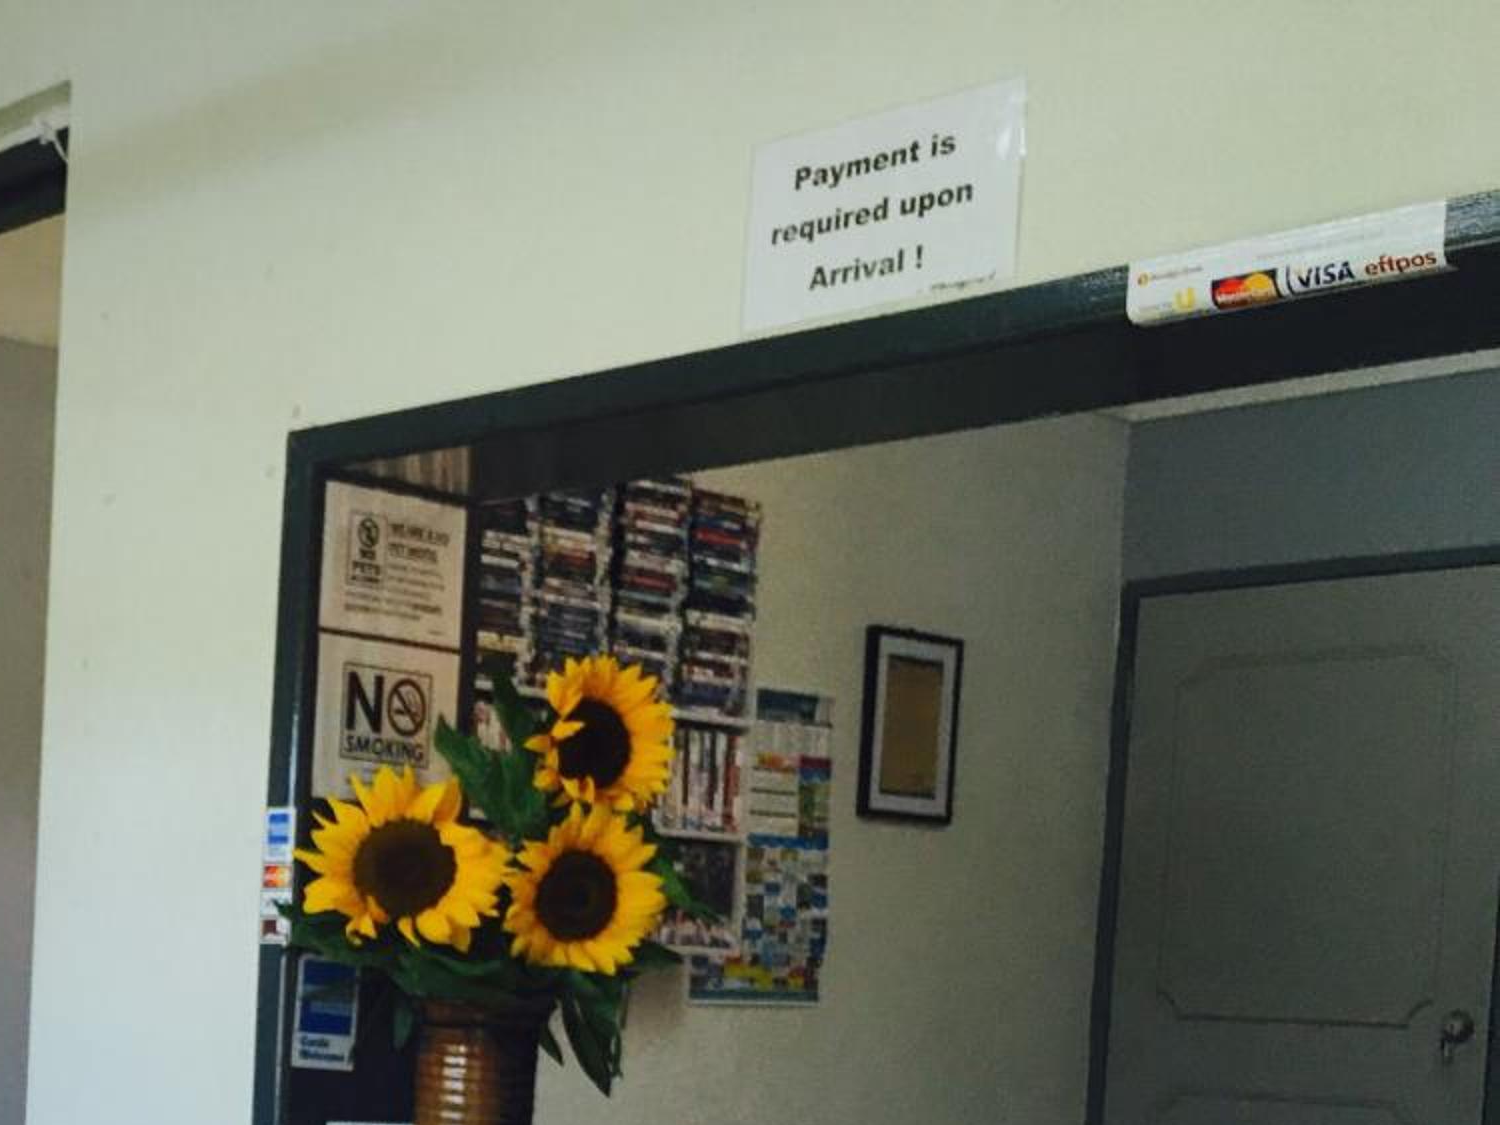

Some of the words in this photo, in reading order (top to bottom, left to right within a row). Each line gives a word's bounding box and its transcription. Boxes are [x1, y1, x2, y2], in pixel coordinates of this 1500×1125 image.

[794, 140, 920, 190] Payment
[930, 133, 957, 158] is
[771, 197, 889, 245] required
[899, 182, 974, 218] upon
[808, 249, 904, 291] Arrival
[1297, 260, 1355, 288] VISA
[1364, 251, 1438, 276] eftpos
